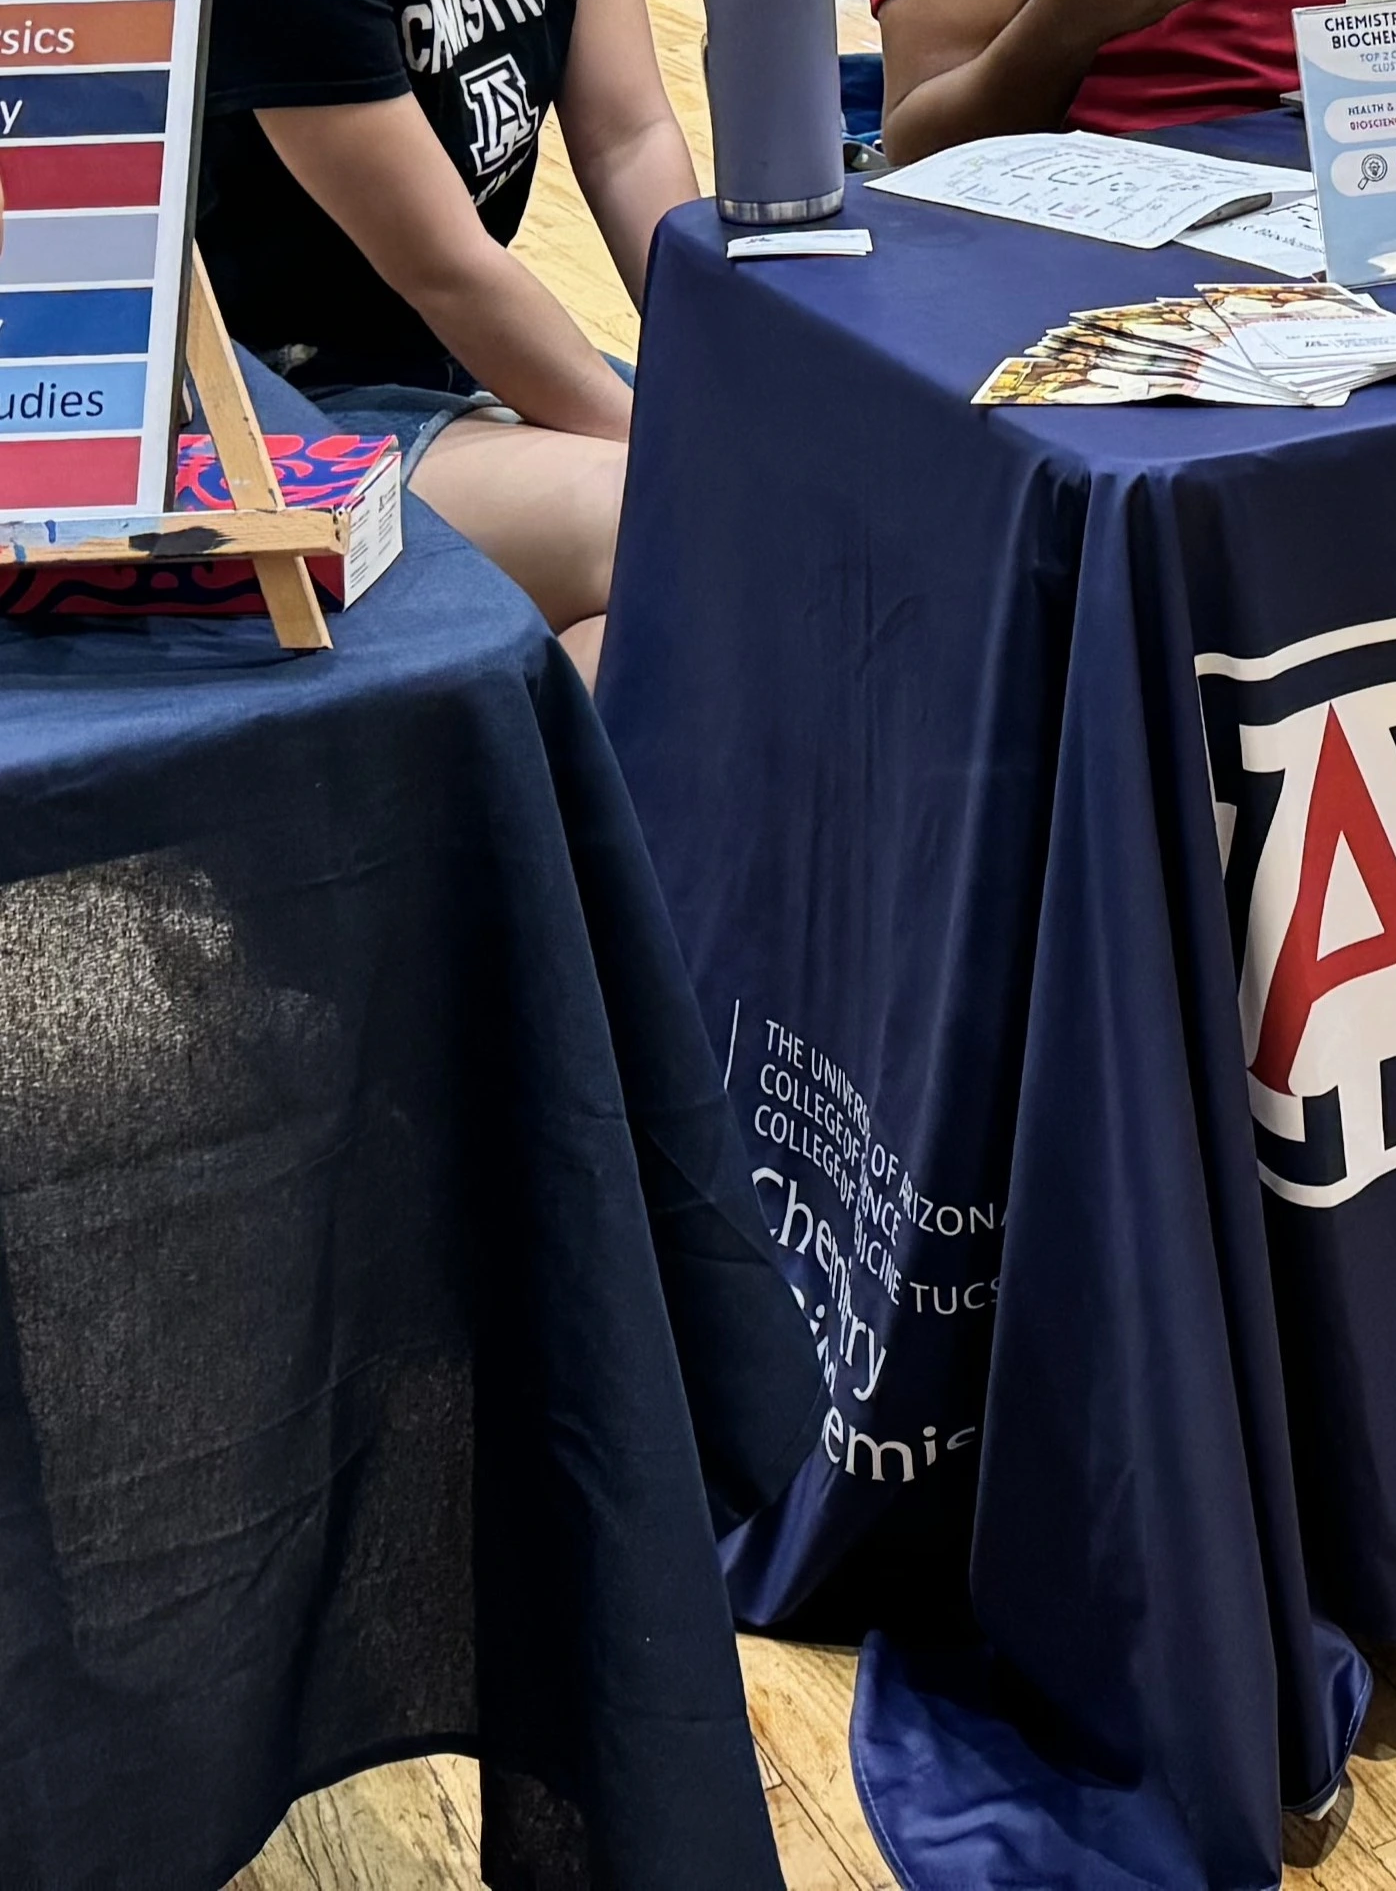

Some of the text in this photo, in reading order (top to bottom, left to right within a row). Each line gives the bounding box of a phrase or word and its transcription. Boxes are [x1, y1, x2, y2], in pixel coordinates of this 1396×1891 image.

[1360, 52, 1380, 62] TOP
[1349, 103, 1384, 116] HEALTH
[754, 1104, 842, 1188] COLLEGE
[840, 1169, 858, 1210] OF
[760, 1063, 844, 1146] COLLEGE
[843, 1127, 861, 1167] OF
[765, 1019, 804, 1069] THE
[871, 1144, 899, 1185] OF
[899, 1171, 1007, 1237] ARIZON
